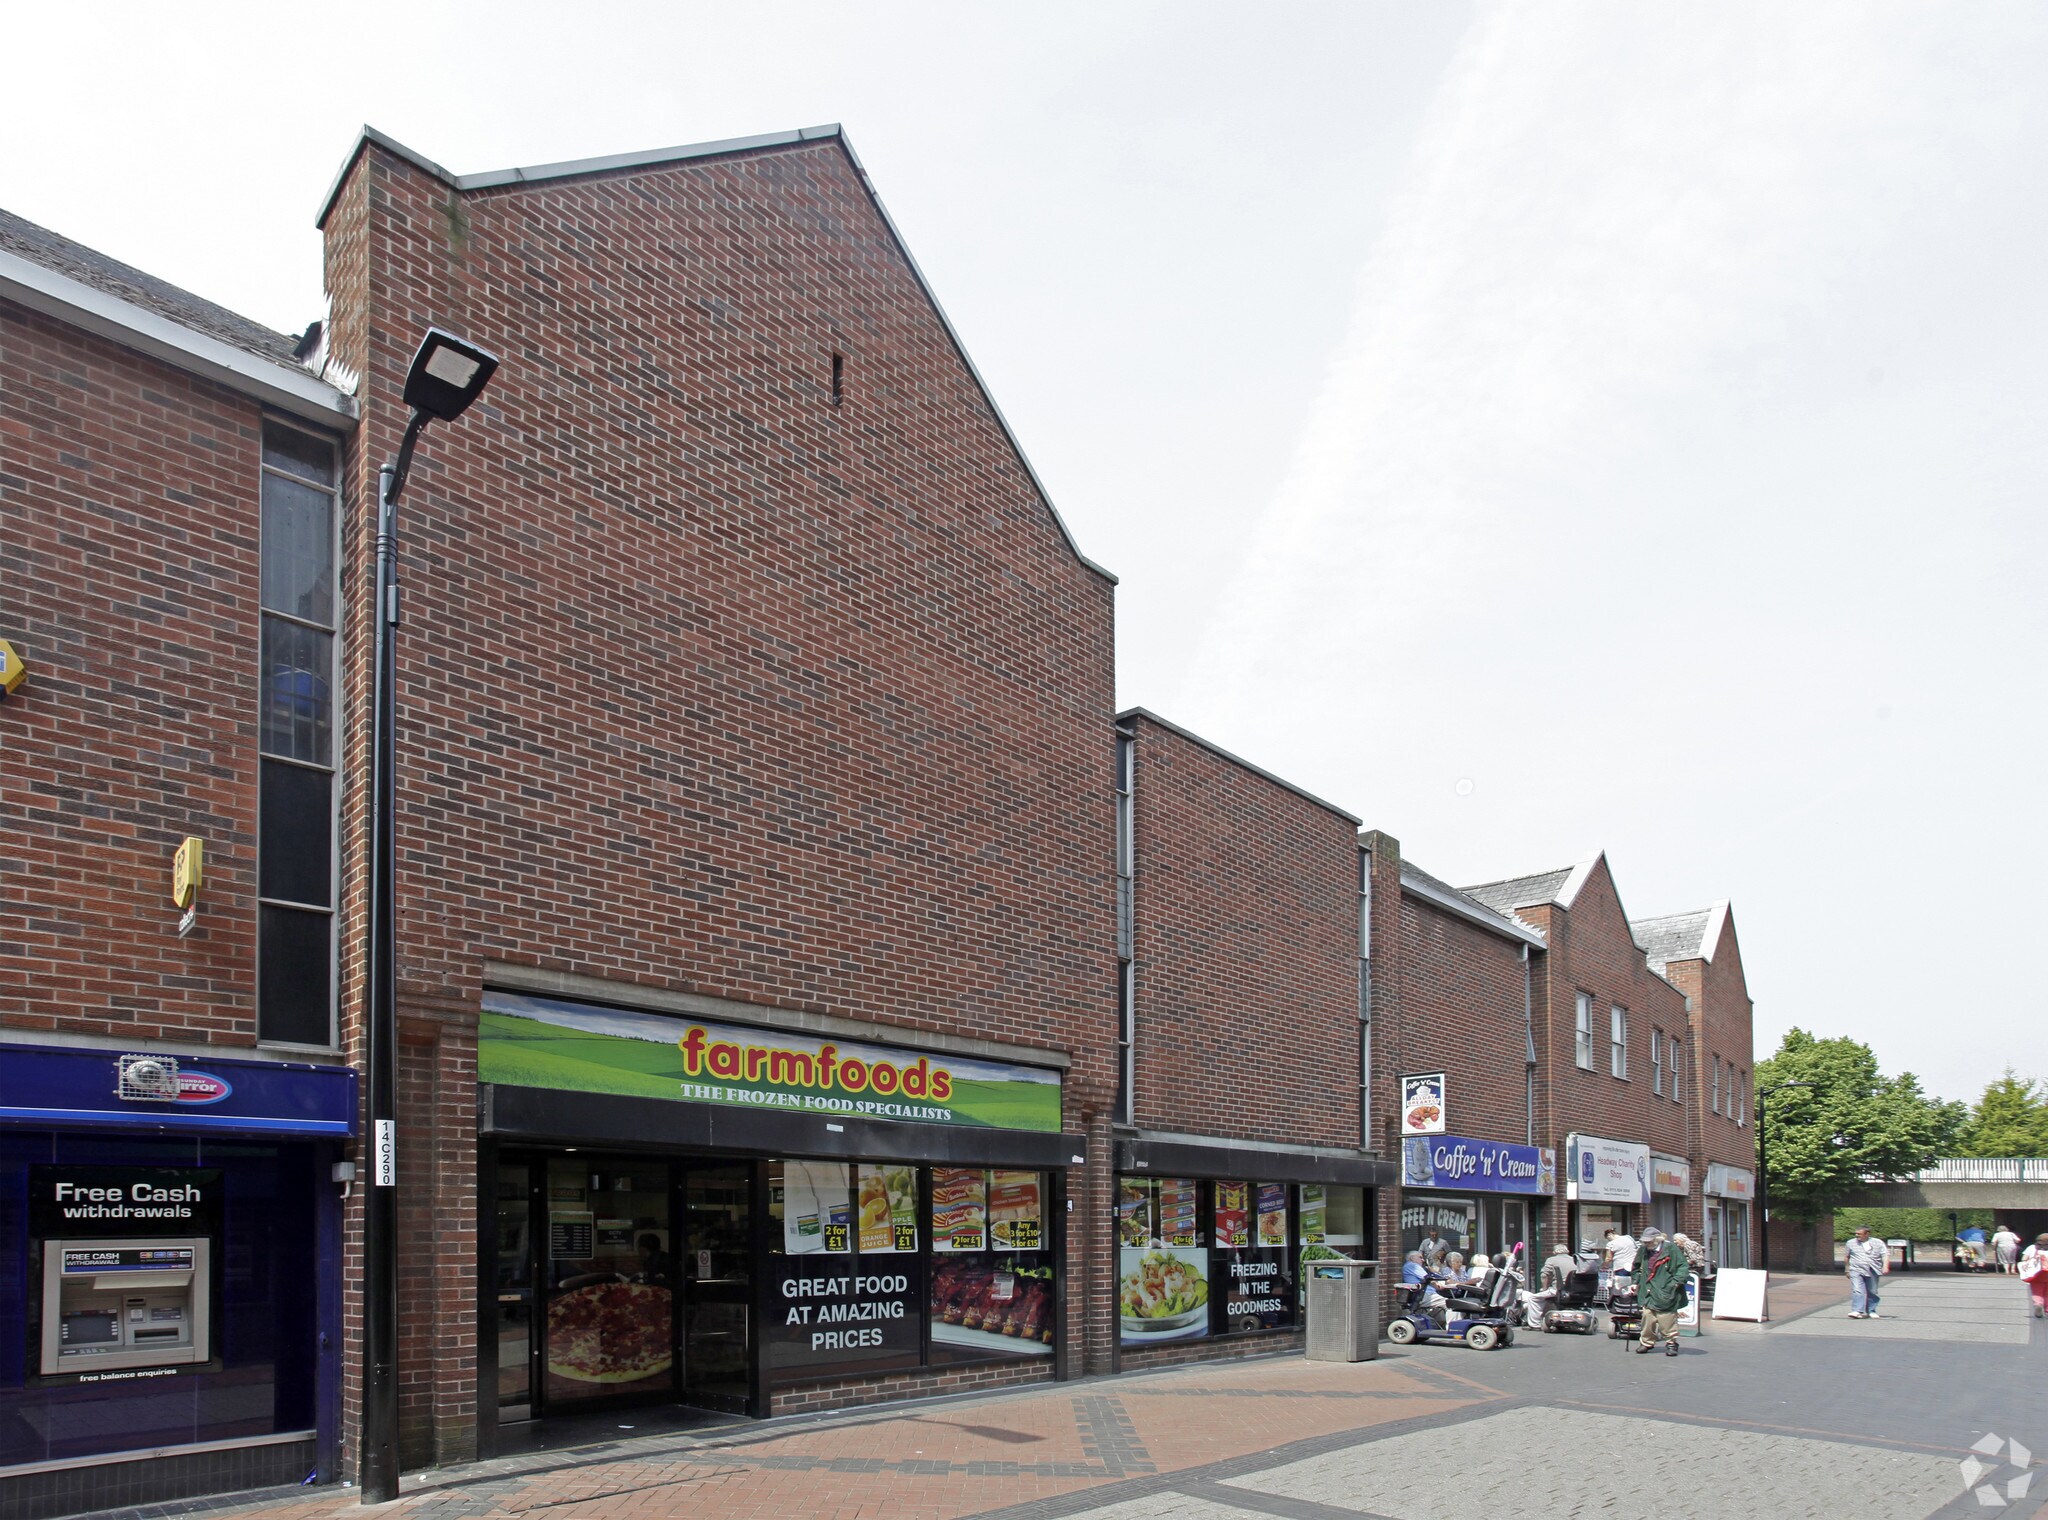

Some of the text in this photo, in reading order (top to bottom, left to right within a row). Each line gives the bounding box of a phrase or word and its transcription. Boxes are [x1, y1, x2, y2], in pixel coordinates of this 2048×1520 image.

[680, 1026, 952, 1101] farmfoods
[680, 1083, 951, 1120] THE FROZEN FOOD SPECIALISTS
[381, 1122, 391, 1185] 14C290
[1434, 1144, 1476, 1179] Coffee
[1499, 1150, 1536, 1177] Cream
[1597, 1156, 1635, 1170] Headway Charity
[1610, 1169, 1622, 1180] Shop
[56, 1183, 201, 1202] Free Cash
[64, 1204, 192, 1218] withdrawals
[1017, 1222, 1031, 1230] Any
[1401, 1206, 1469, 1235] FFEE N CREAM
[825, 1226, 832, 1235] 2
[832, 1225, 847, 1235] for
[895, 1226, 901, 1235] 2
[901, 1225, 914, 1235] for
[829, 1236, 842, 1247] £1
[861, 1233, 888, 1242] ORANGE
[862, 1239, 889, 1248] JUICE
[898, 1236, 910, 1247] £1
[952, 1237, 961, 1248] 2
[1027, 1239, 1038, 1247] £15
[66, 1252, 120, 1261] FREE CASH
[1231, 1263, 1277, 1277] FREEZING
[782, 1275, 908, 1298] GREAT FOOD
[1239, 1281, 1270, 1295] IN THE
[786, 1301, 904, 1325] AT AMAZING
[1227, 1299, 1281, 1316] GOODNESS
[812, 1328, 883, 1351] PRICES
[101, 1371, 135, 1380] balance
[137, 1368, 177, 1379] enquiries
